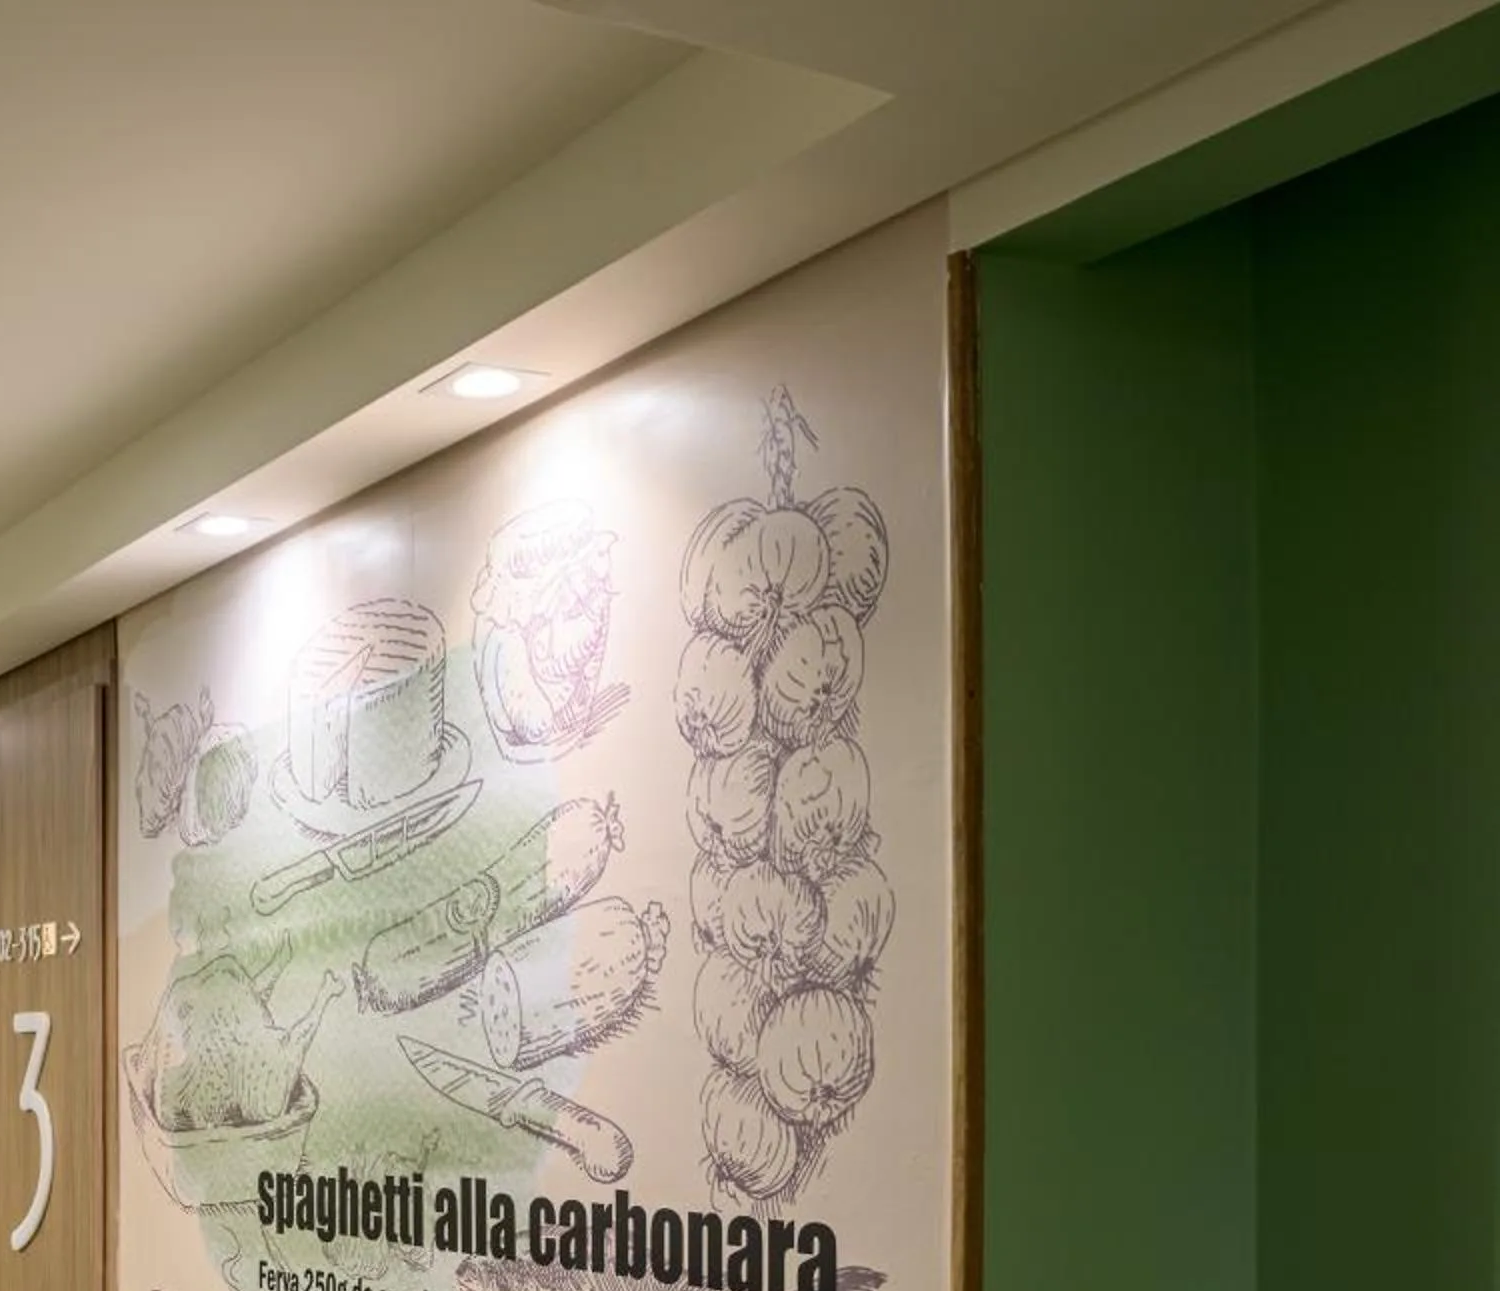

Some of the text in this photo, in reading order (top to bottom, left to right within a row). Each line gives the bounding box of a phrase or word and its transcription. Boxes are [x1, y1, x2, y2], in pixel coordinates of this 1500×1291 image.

[11, 1010, 54, 1252] 3
[257, 1166, 424, 1247] spaghetti
[435, 1176, 516, 1261] alla
